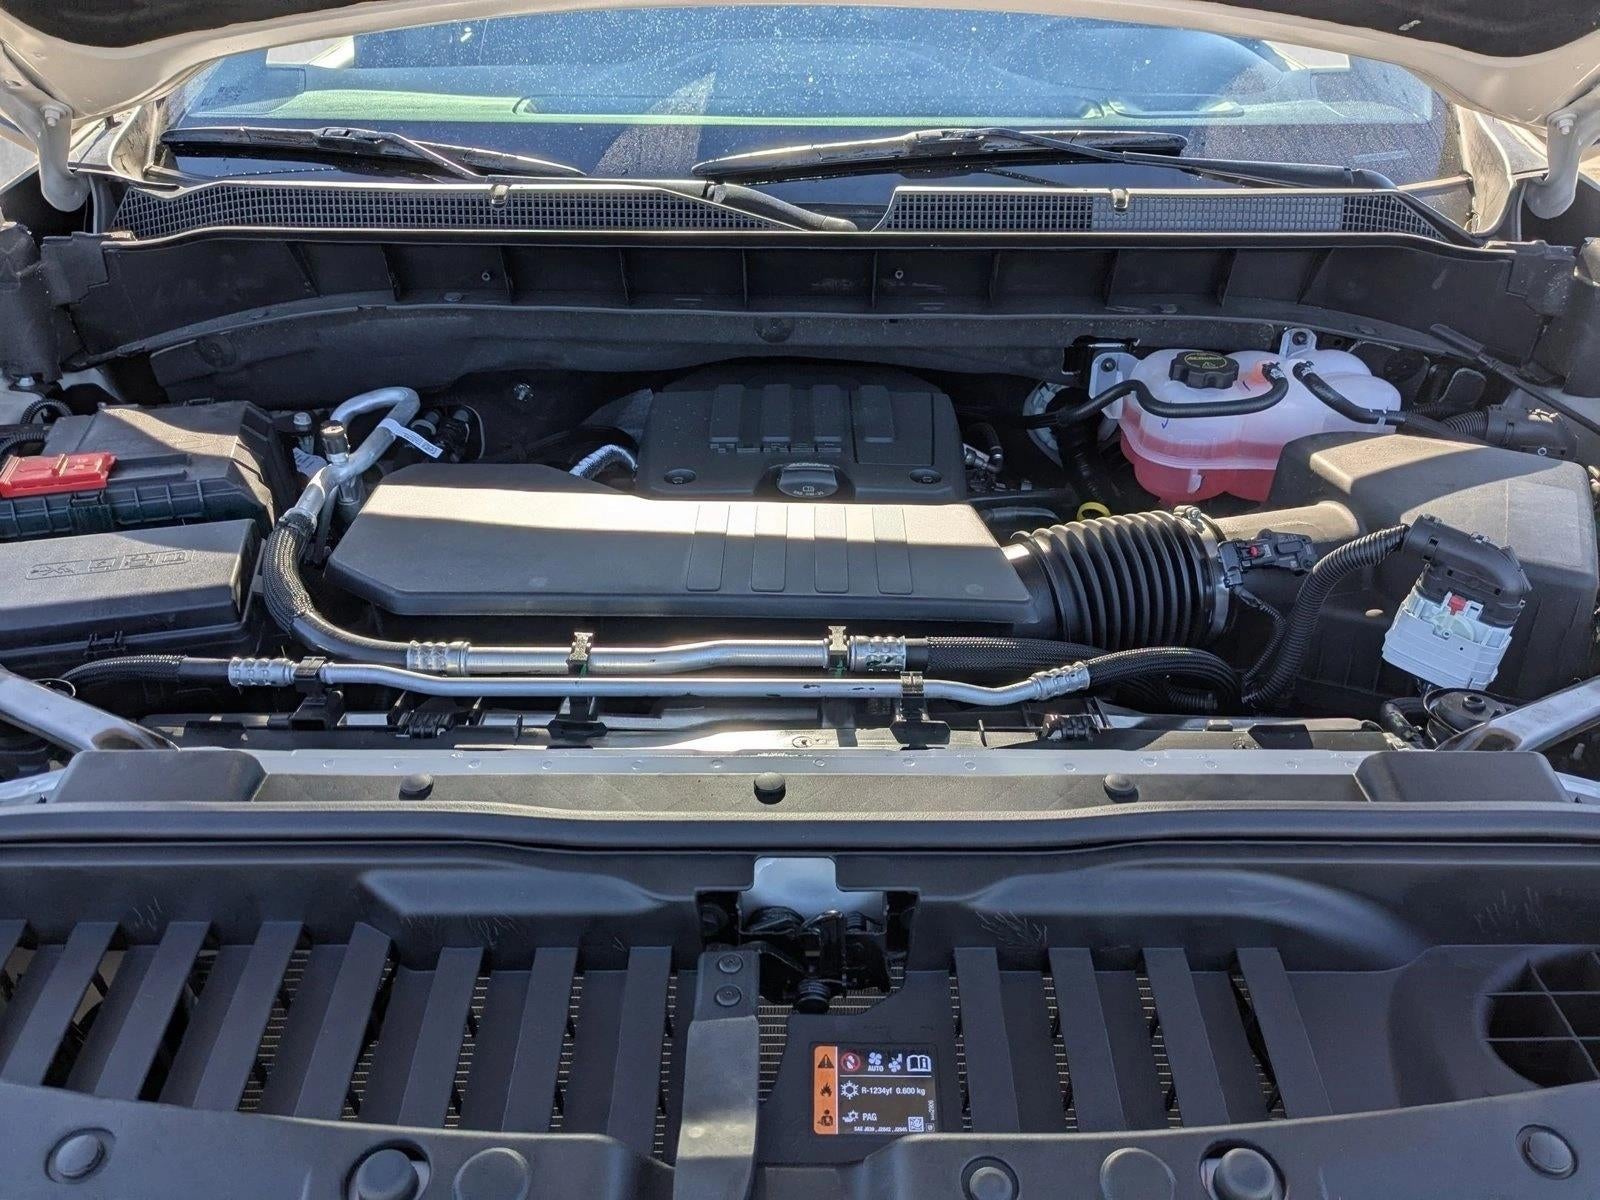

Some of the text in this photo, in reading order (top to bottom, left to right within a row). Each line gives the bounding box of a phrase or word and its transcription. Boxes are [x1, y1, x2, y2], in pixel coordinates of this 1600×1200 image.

[861, 1086, 926, 1097] R-1234yf 0.600 kg
[862, 1112, 878, 1121] PAG
